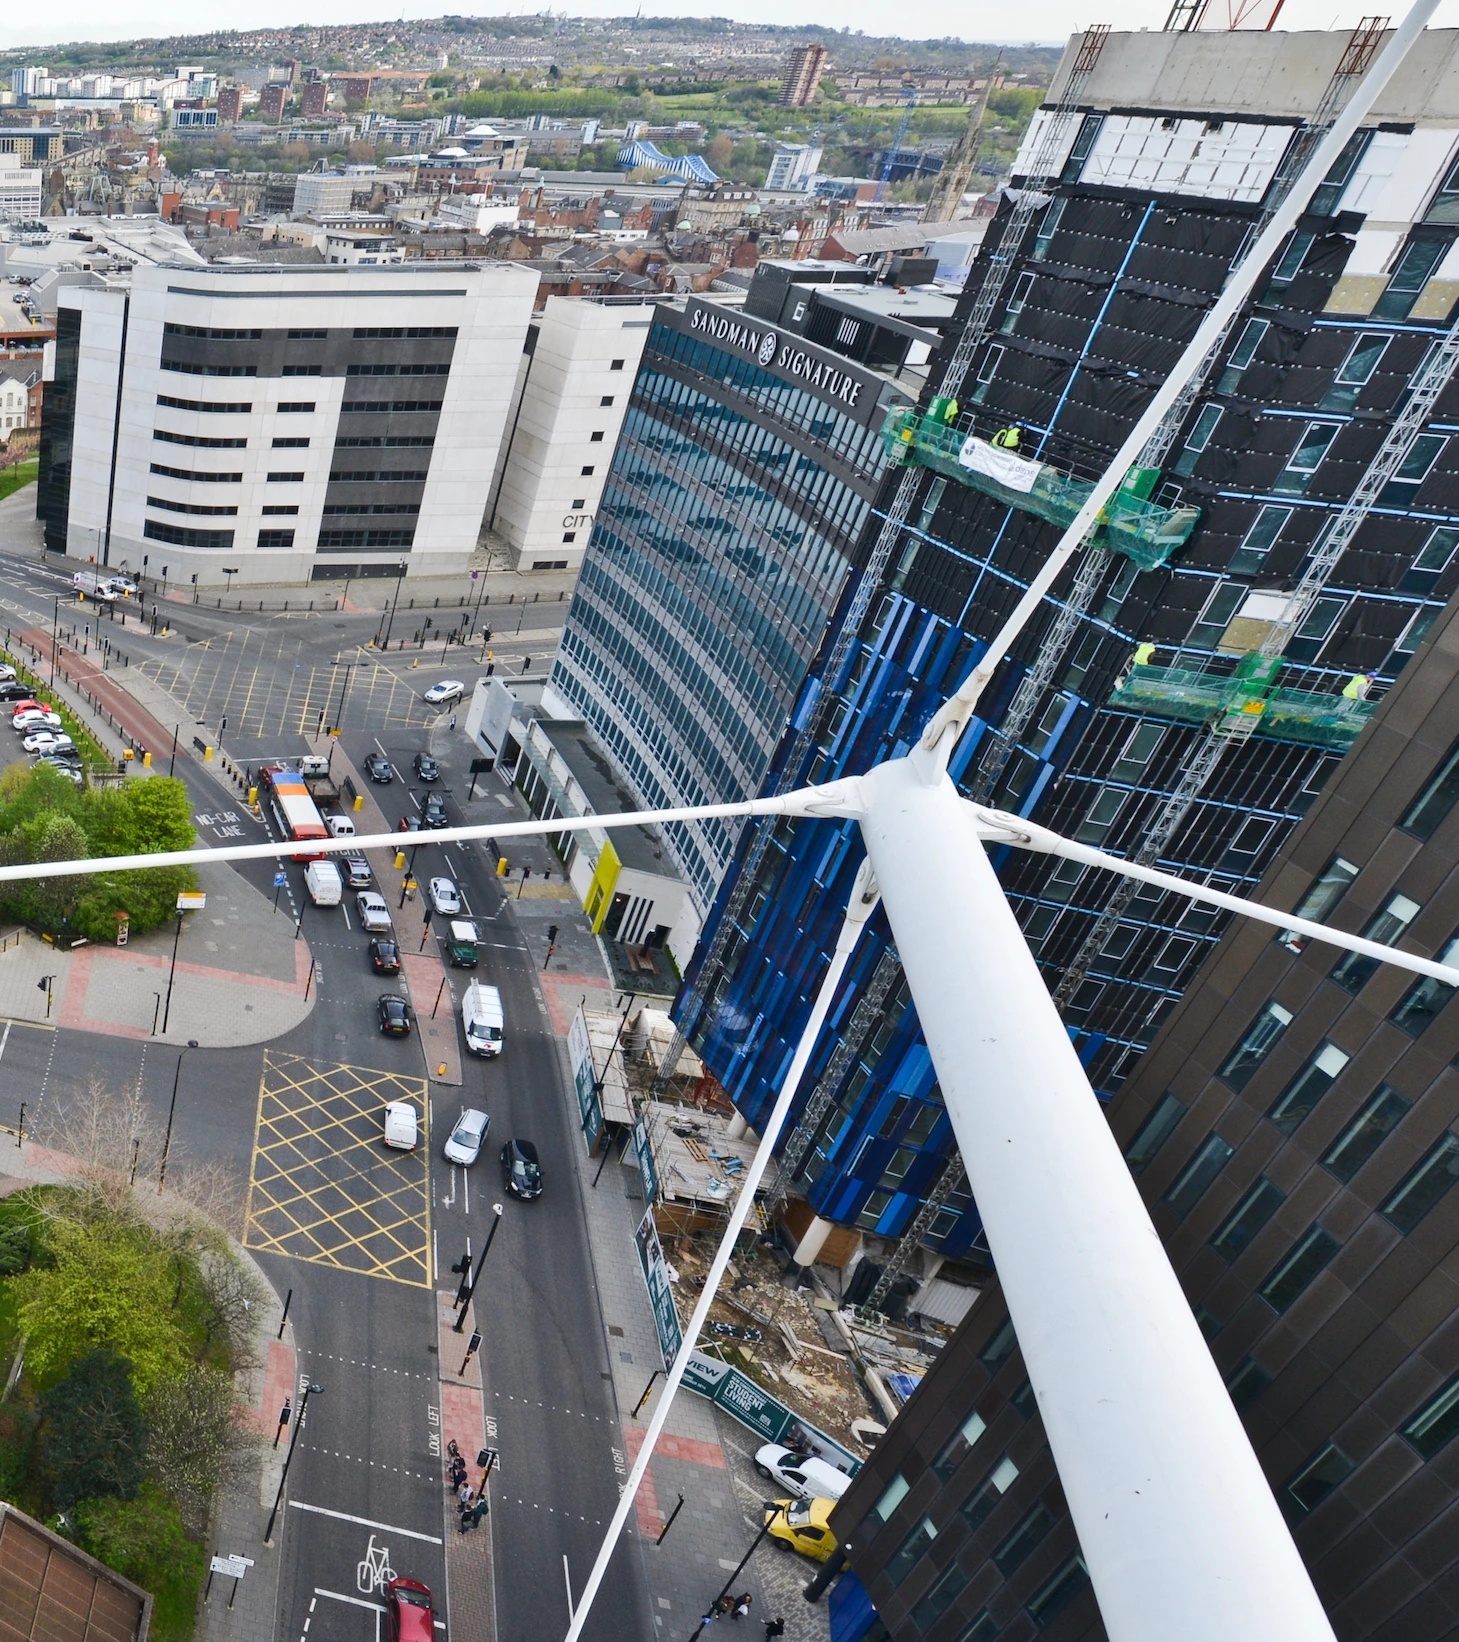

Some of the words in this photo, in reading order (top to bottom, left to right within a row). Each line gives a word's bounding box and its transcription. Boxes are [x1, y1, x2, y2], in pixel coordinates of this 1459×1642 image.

[691, 309, 761, 354] SANDMAN
[778, 345, 862, 407] SIGNATURE
[562, 514, 596, 528] CITY
[195, 811, 242, 827] NO-CAR
[212, 824, 246, 839] LANE
[687, 1359, 720, 1377] VIEW
[297, 1373, 310, 1395] LOOK
[728, 1380, 766, 1411] STUDENT
[724, 1386, 752, 1412] LIVING
[427, 1404, 440, 1427] LEFT
[485, 1415, 498, 1440] LOOK
[428, 1431, 441, 1457] LOOK
[611, 1446, 627, 1476] RIGHT
